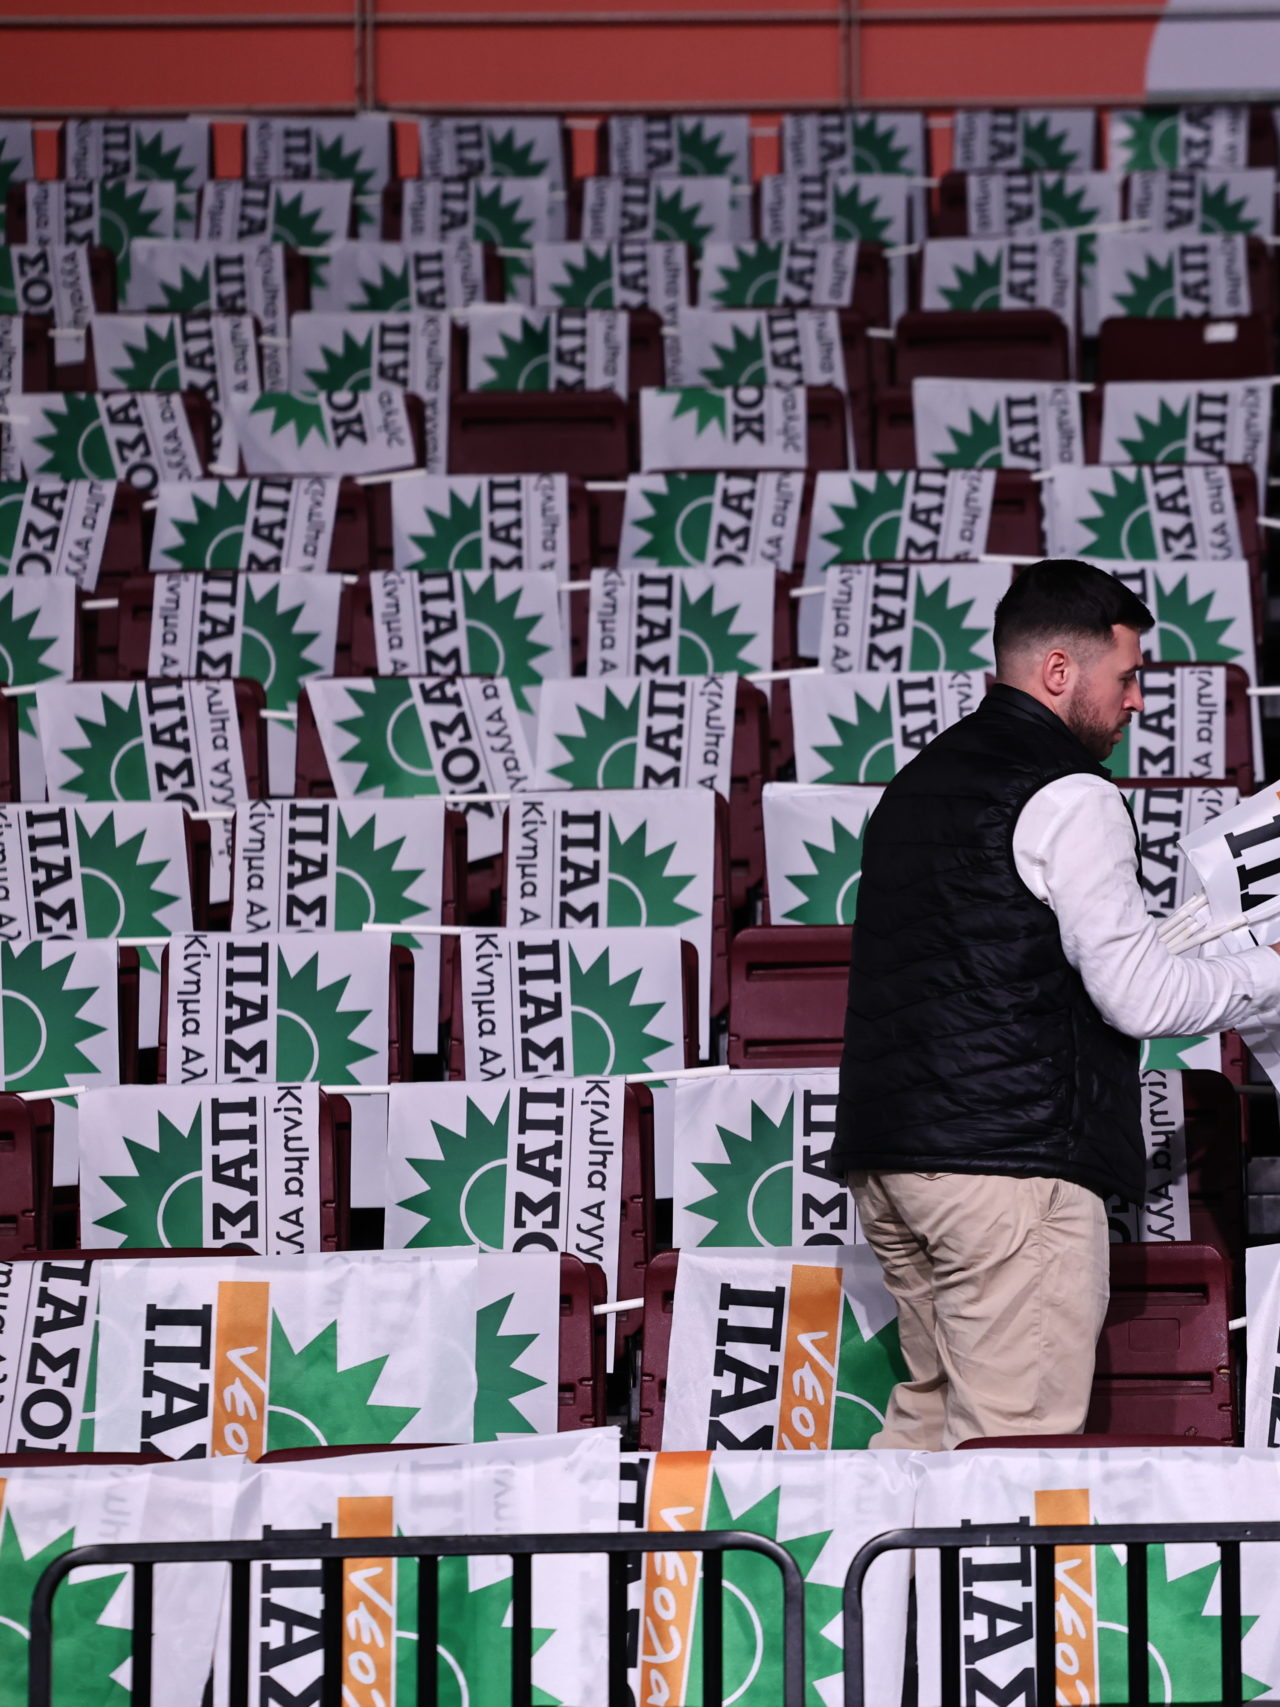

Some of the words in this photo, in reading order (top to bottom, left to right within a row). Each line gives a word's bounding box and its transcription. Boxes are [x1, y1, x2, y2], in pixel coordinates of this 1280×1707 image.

[24, 807, 79, 941] ΠΑΣ
[243, 799, 275, 894] Κίνημα
[286, 803, 331, 933] ΠΑΣ
[516, 801, 545, 899] Κίνημα
[177, 932, 211, 1038] Κίνημα
[225, 940, 270, 1083] ΠΑΣ
[471, 933, 506, 1038] Κίνημα
[516, 939, 565, 1081] ΠΑΣ
[213, 1344, 268, 1460] νεο
